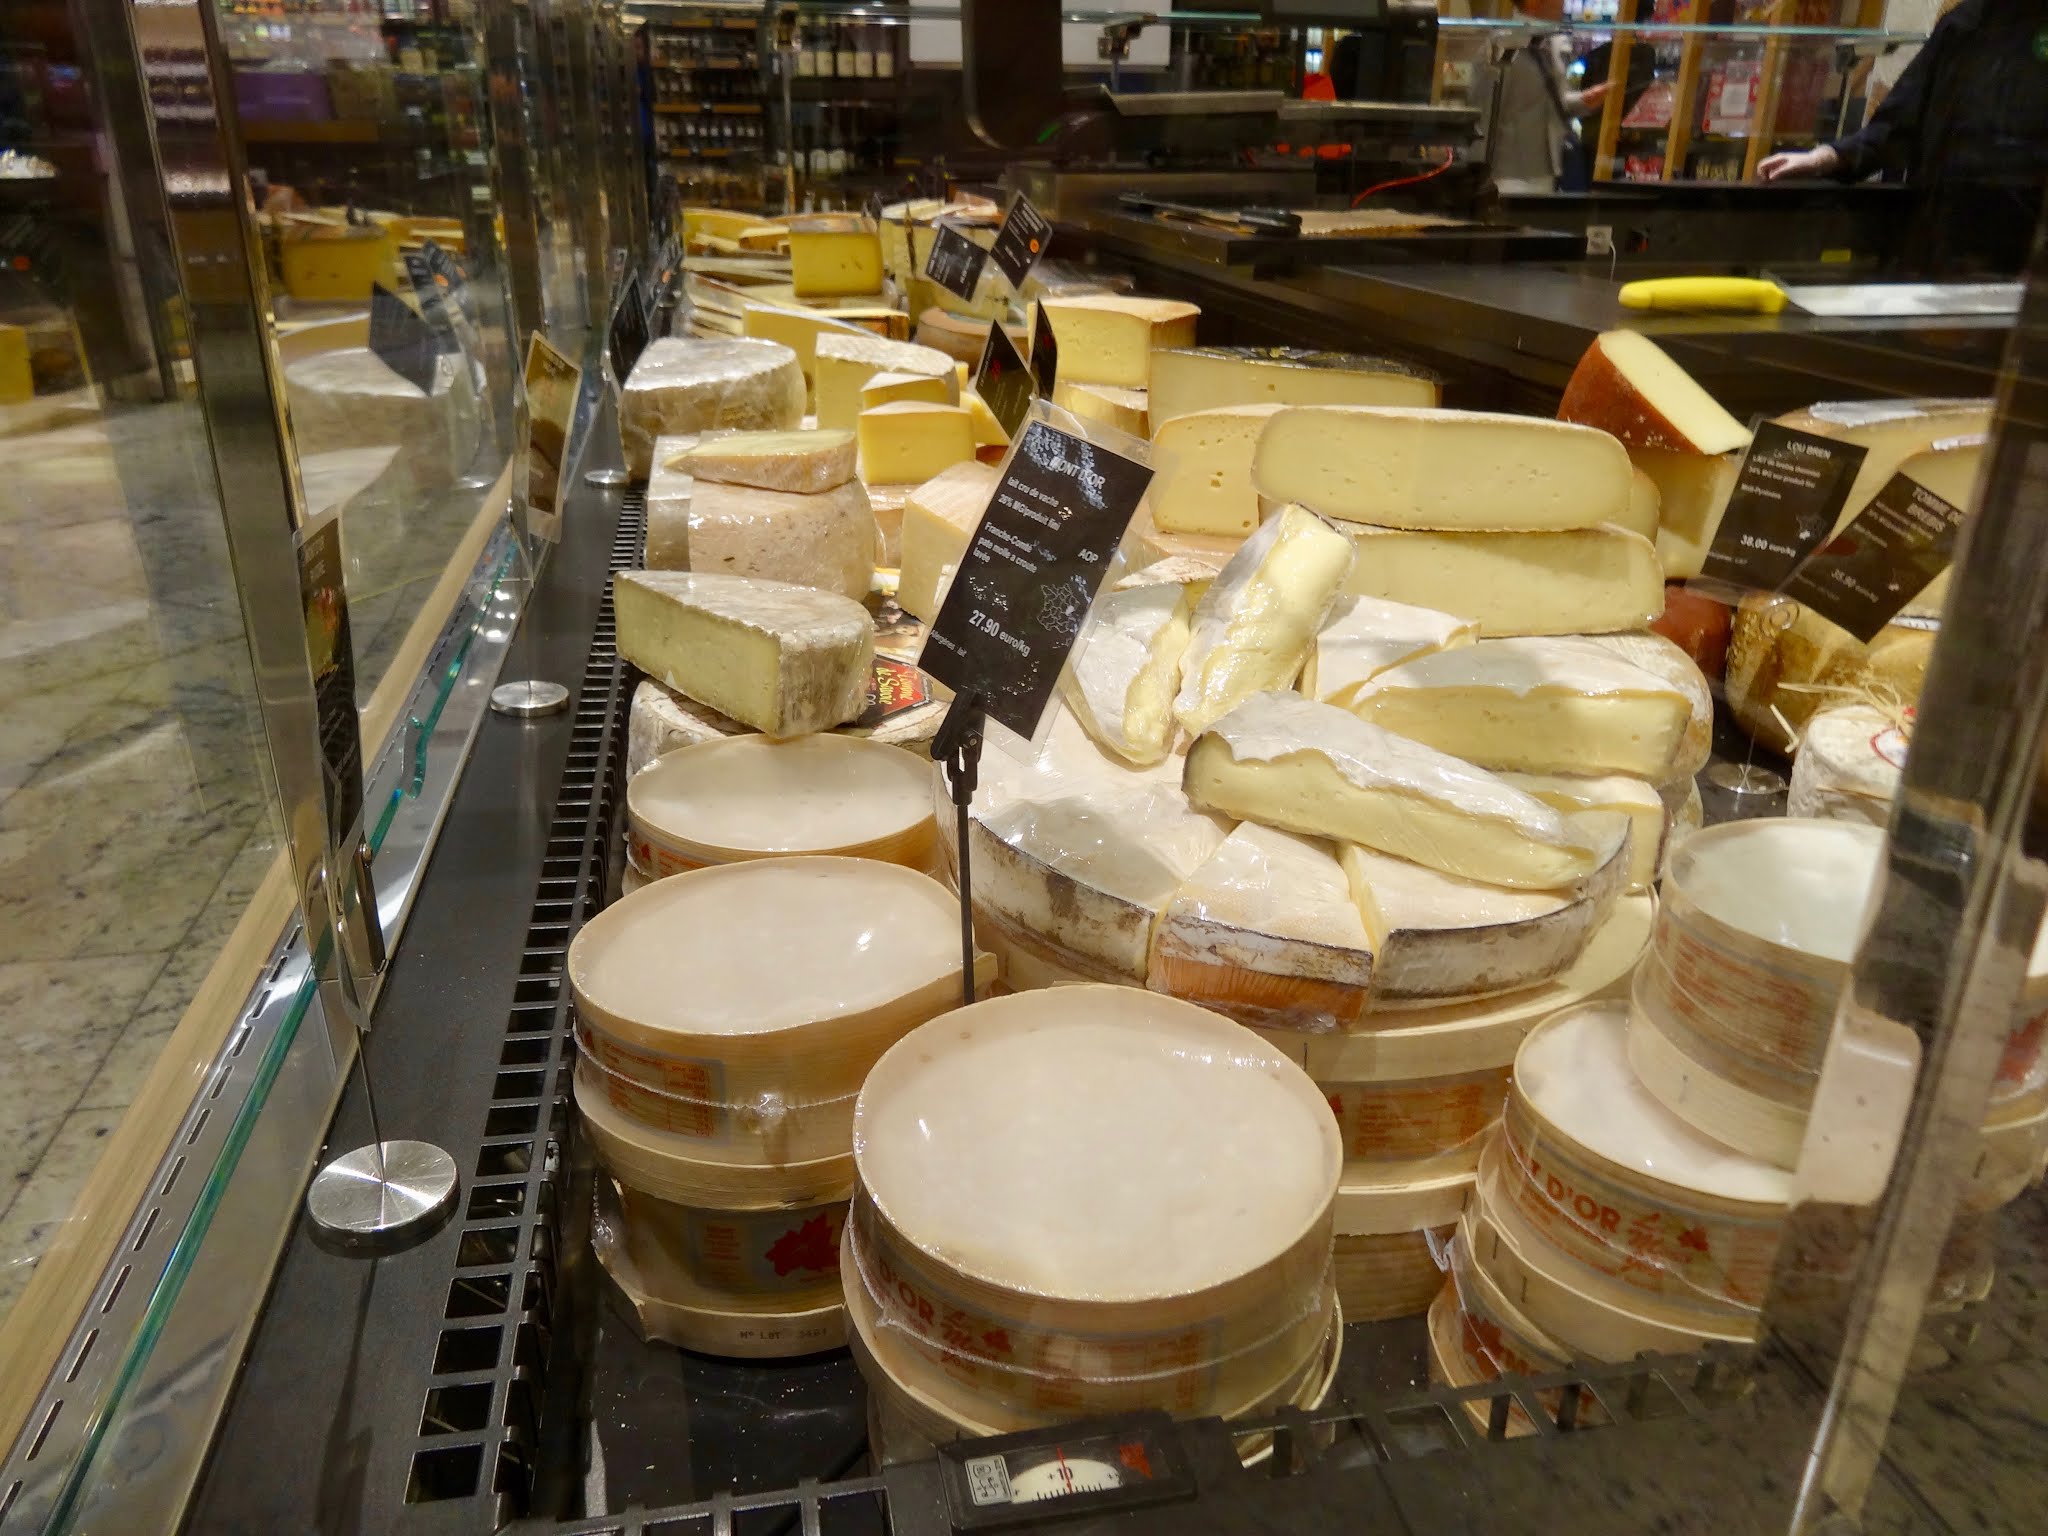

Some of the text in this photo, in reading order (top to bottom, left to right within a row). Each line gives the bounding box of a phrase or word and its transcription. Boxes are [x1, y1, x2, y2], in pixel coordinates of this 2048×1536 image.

[1049, 456, 1081, 477] MONT
[1007, 476, 1060, 508] lait cru de vache
[984, 521, 1033, 553] Franche-Comté
[978, 537, 994, 550] pate
[992, 544, 1011, 559] molle
[1015, 556, 1038, 574] croute
[1077, 548, 1099, 564] AOP
[968, 609, 1032, 658] 27.90 euro/kg
[1546, 1174, 1623, 1235] D'OR
